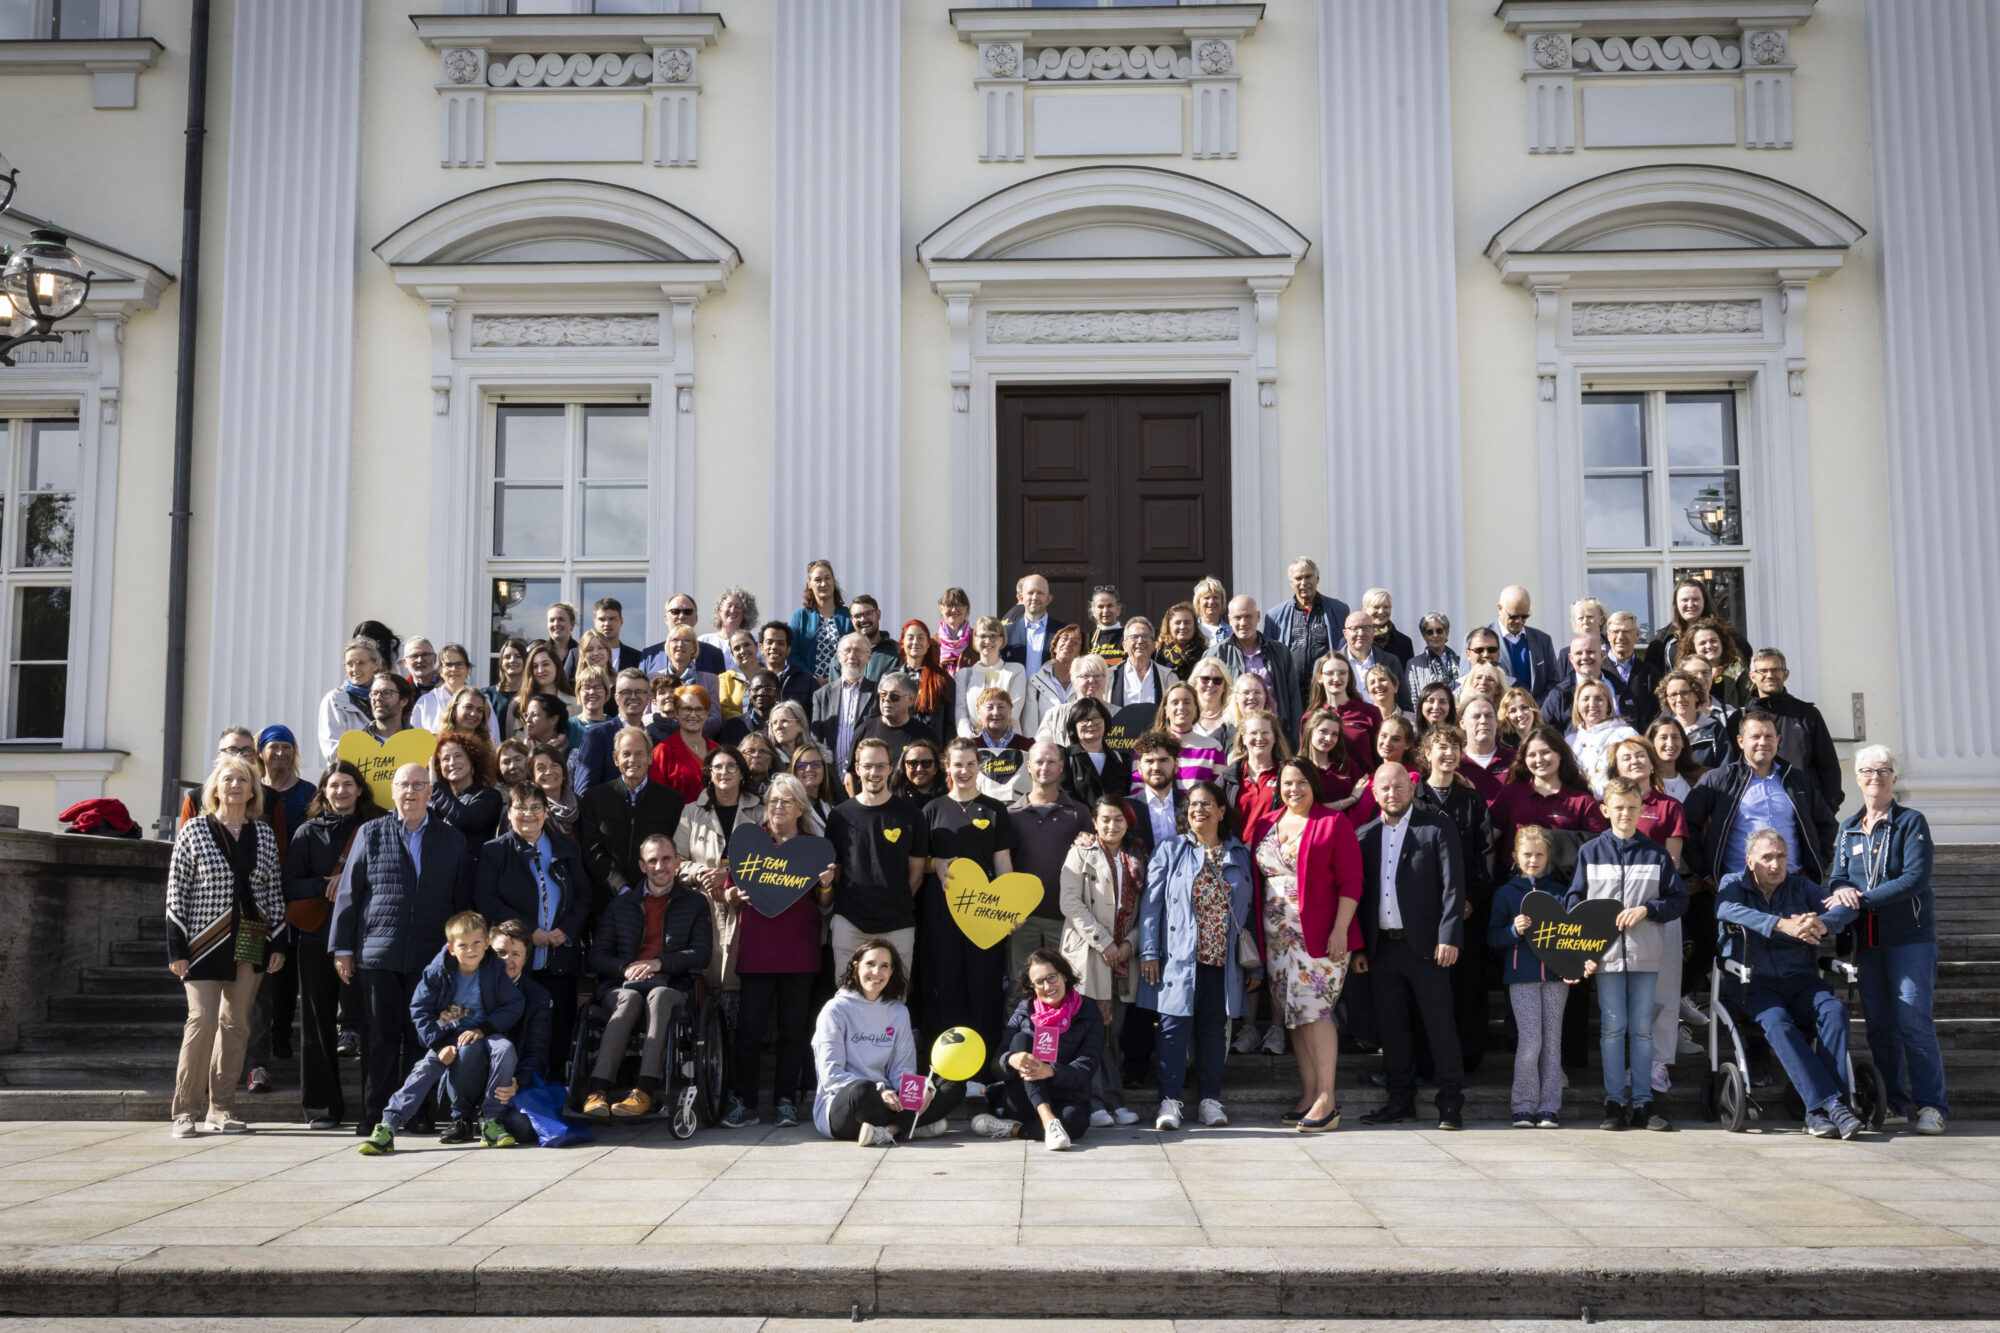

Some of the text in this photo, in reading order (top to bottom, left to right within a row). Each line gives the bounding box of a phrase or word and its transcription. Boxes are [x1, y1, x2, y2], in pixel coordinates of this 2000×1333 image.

[373, 769, 397, 781] EHRE
[736, 853, 788, 881] #TEAM
[758, 872, 811, 889] EHRENAMT
[953, 888, 1001, 914] #TEAM
[973, 907, 1021, 923] EHRENAMT
[1532, 921, 1582, 949] #TEAM
[1555, 939, 1607, 953] EHRENAMT
